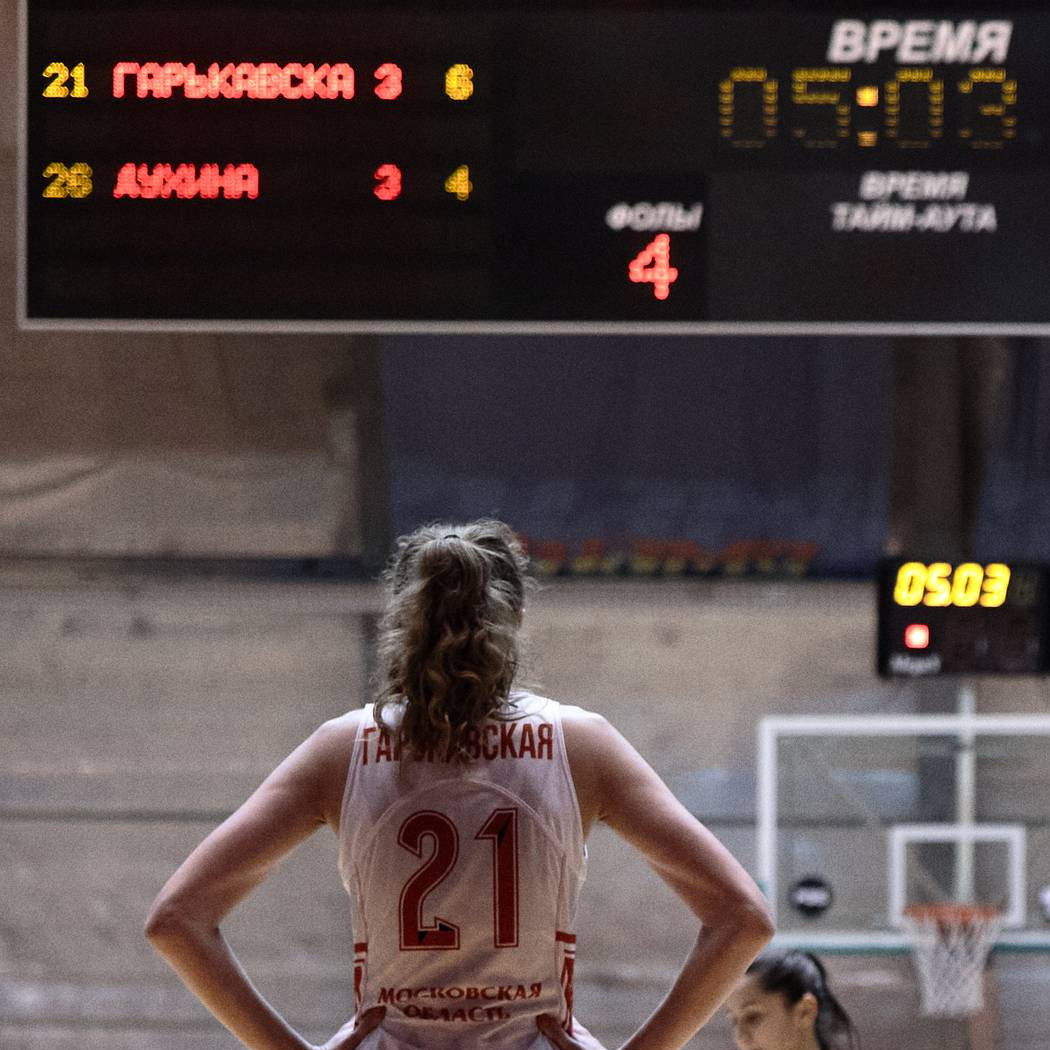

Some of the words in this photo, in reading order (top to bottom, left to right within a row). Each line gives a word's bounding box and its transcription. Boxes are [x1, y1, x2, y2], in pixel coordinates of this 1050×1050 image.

[826, 20, 1013, 63] ВРЕМЯ
[42, 62, 89, 98] 21
[113, 62, 355, 99] ГАРЬКАВСКА
[374, 63, 402, 100] 3
[445, 64, 474, 100] 6
[718, 66, 1018, 148] 05:03
[374, 164, 402, 200] 3
[444, 164, 473, 201] 4
[858, 171, 969, 200] ВРЕМЯ
[605, 202, 704, 231] ФОЛЫ
[829, 202, 998, 232] ТАЙМ-АУТА
[629, 233, 678, 299] 4
[397, 807, 519, 951] 21
